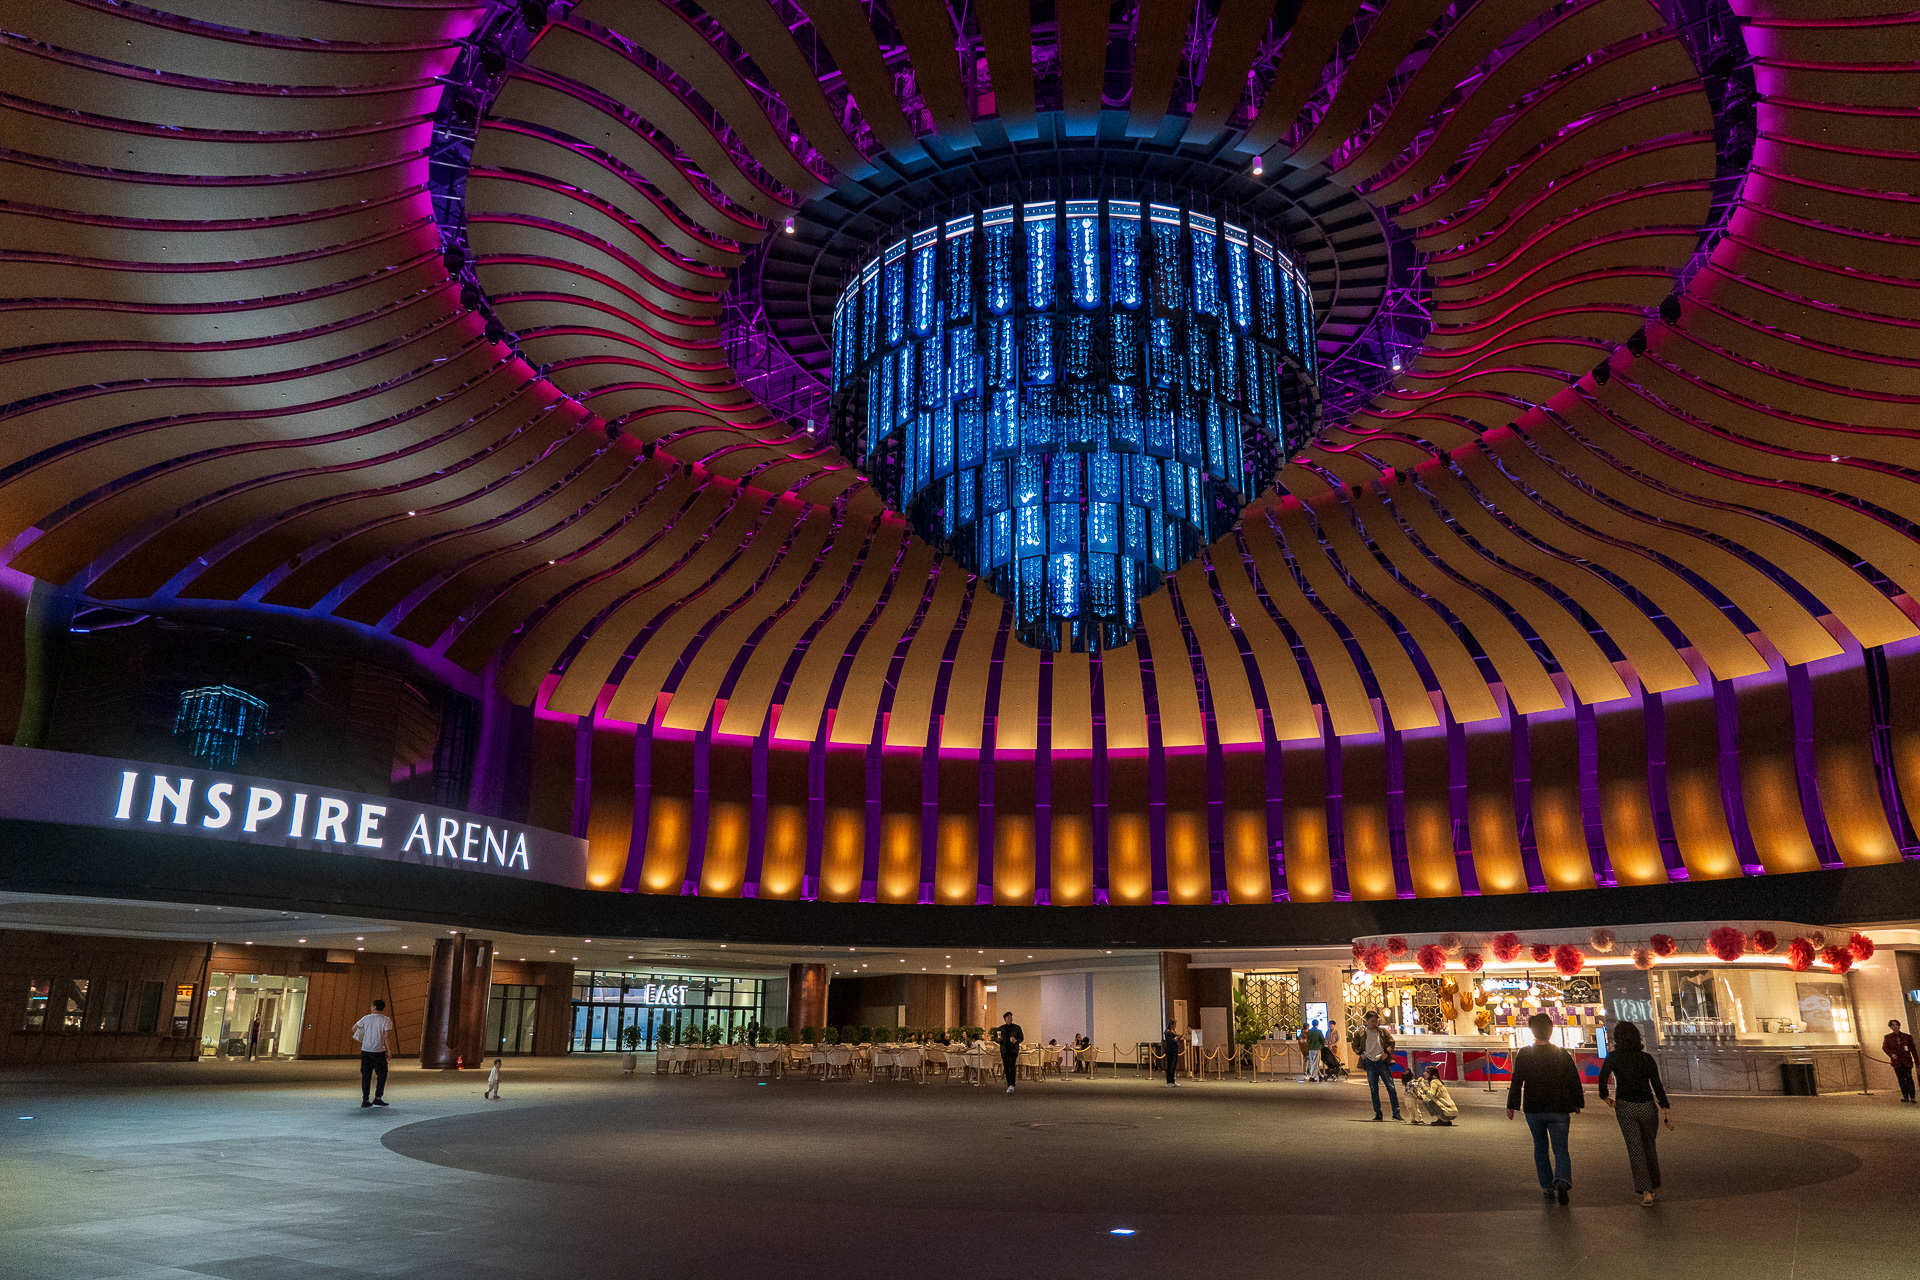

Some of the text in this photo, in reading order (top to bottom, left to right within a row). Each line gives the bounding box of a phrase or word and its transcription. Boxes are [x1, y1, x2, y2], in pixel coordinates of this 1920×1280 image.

[114, 771, 530, 871] INSPIRE ARENA
[644, 983, 689, 1006] EAST
